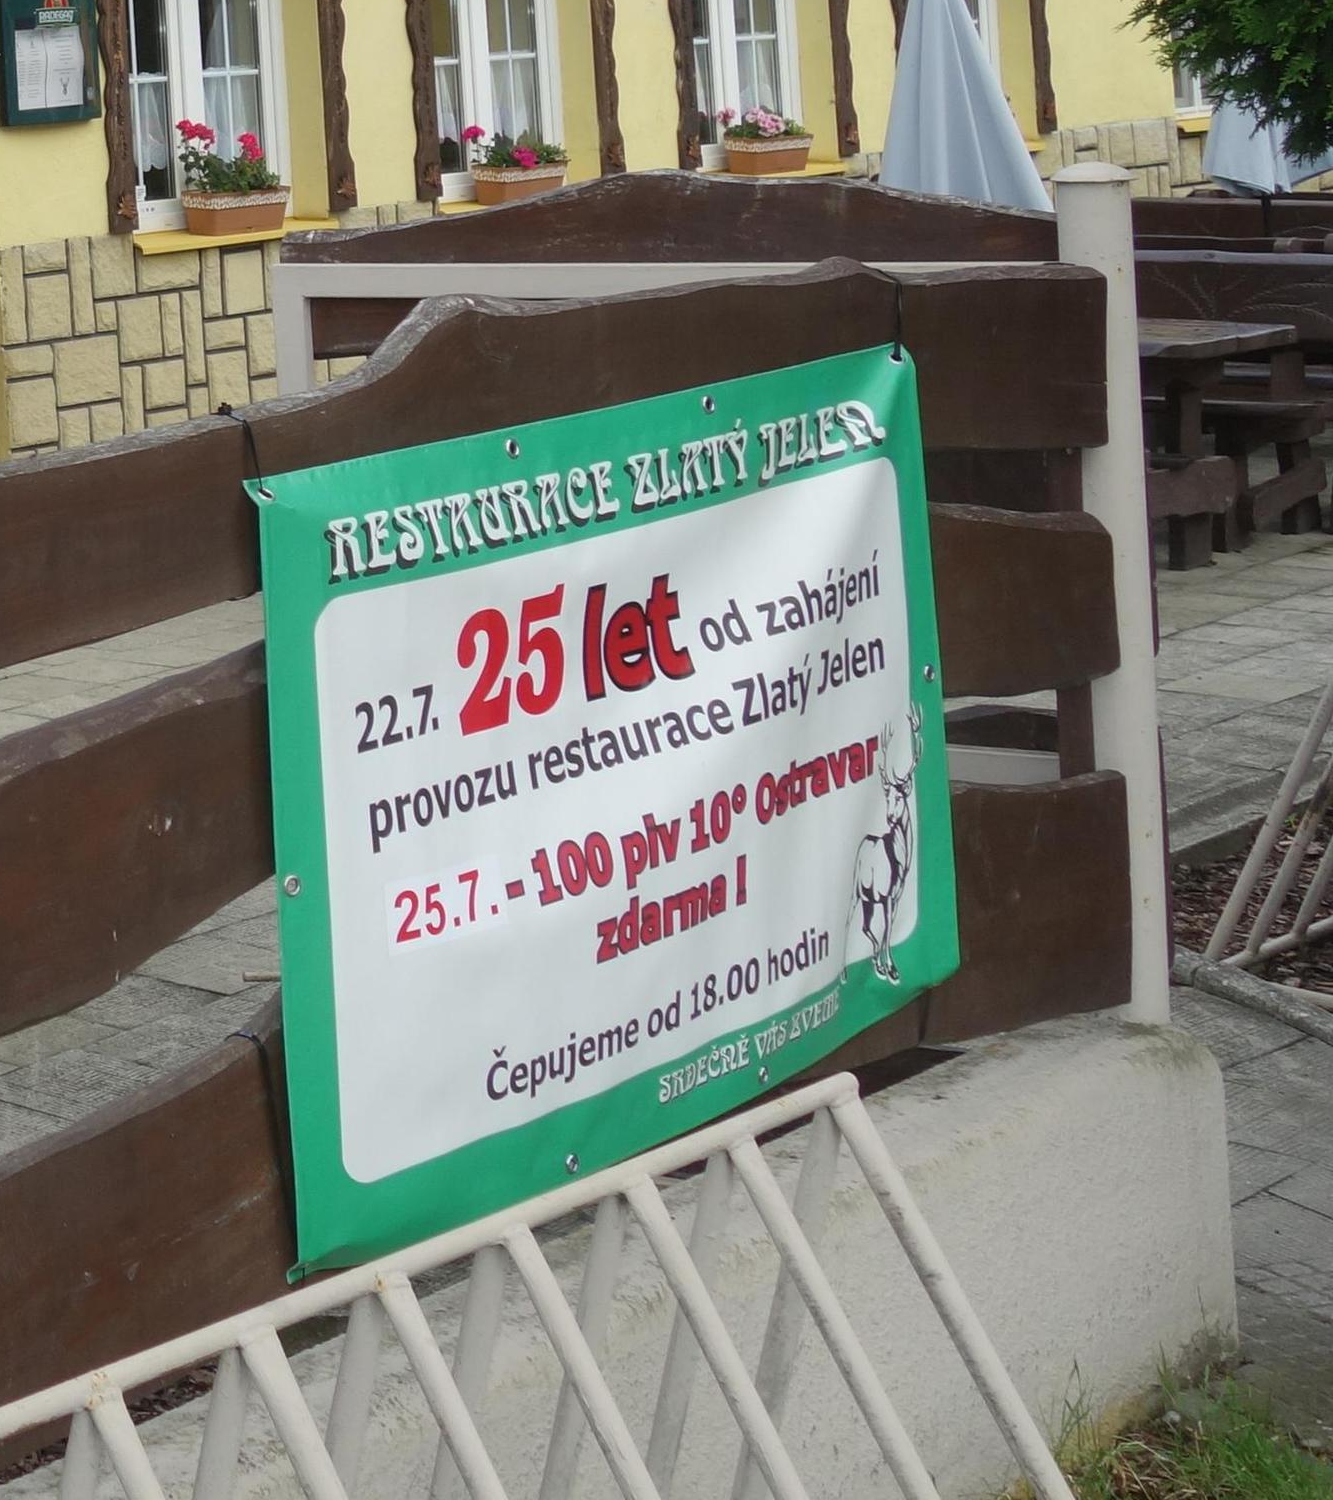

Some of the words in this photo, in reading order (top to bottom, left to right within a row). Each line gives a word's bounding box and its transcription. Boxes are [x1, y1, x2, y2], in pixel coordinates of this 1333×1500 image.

[326, 461, 621, 583] RESTAURACE
[624, 418, 748, 512] ZLATÝ
[758, 400, 886, 486] JELEN
[355, 683, 440, 755] 22.7.
[456, 583, 566, 737] 25
[583, 573, 696, 702] let
[699, 598, 753, 652] od
[756, 548, 881, 636] zahájení
[369, 760, 518, 854] provozu
[528, 699, 735, 790] restaurace
[731, 653, 812, 727] Zlatý
[817, 637, 885, 695] Jelen
[394, 869, 499, 943] 25.7.
[755, 735, 879, 825] Ostravar
[596, 874, 727, 964] zdarma
[486, 1018, 639, 1101] Čepujeme
[647, 990, 681, 1038] od
[690, 957, 760, 1021] 18.00
[767, 927, 830, 986] hodin
[658, 1034, 751, 1104] SRDEČNĚ
[754, 1020, 789, 1060] VÁS
